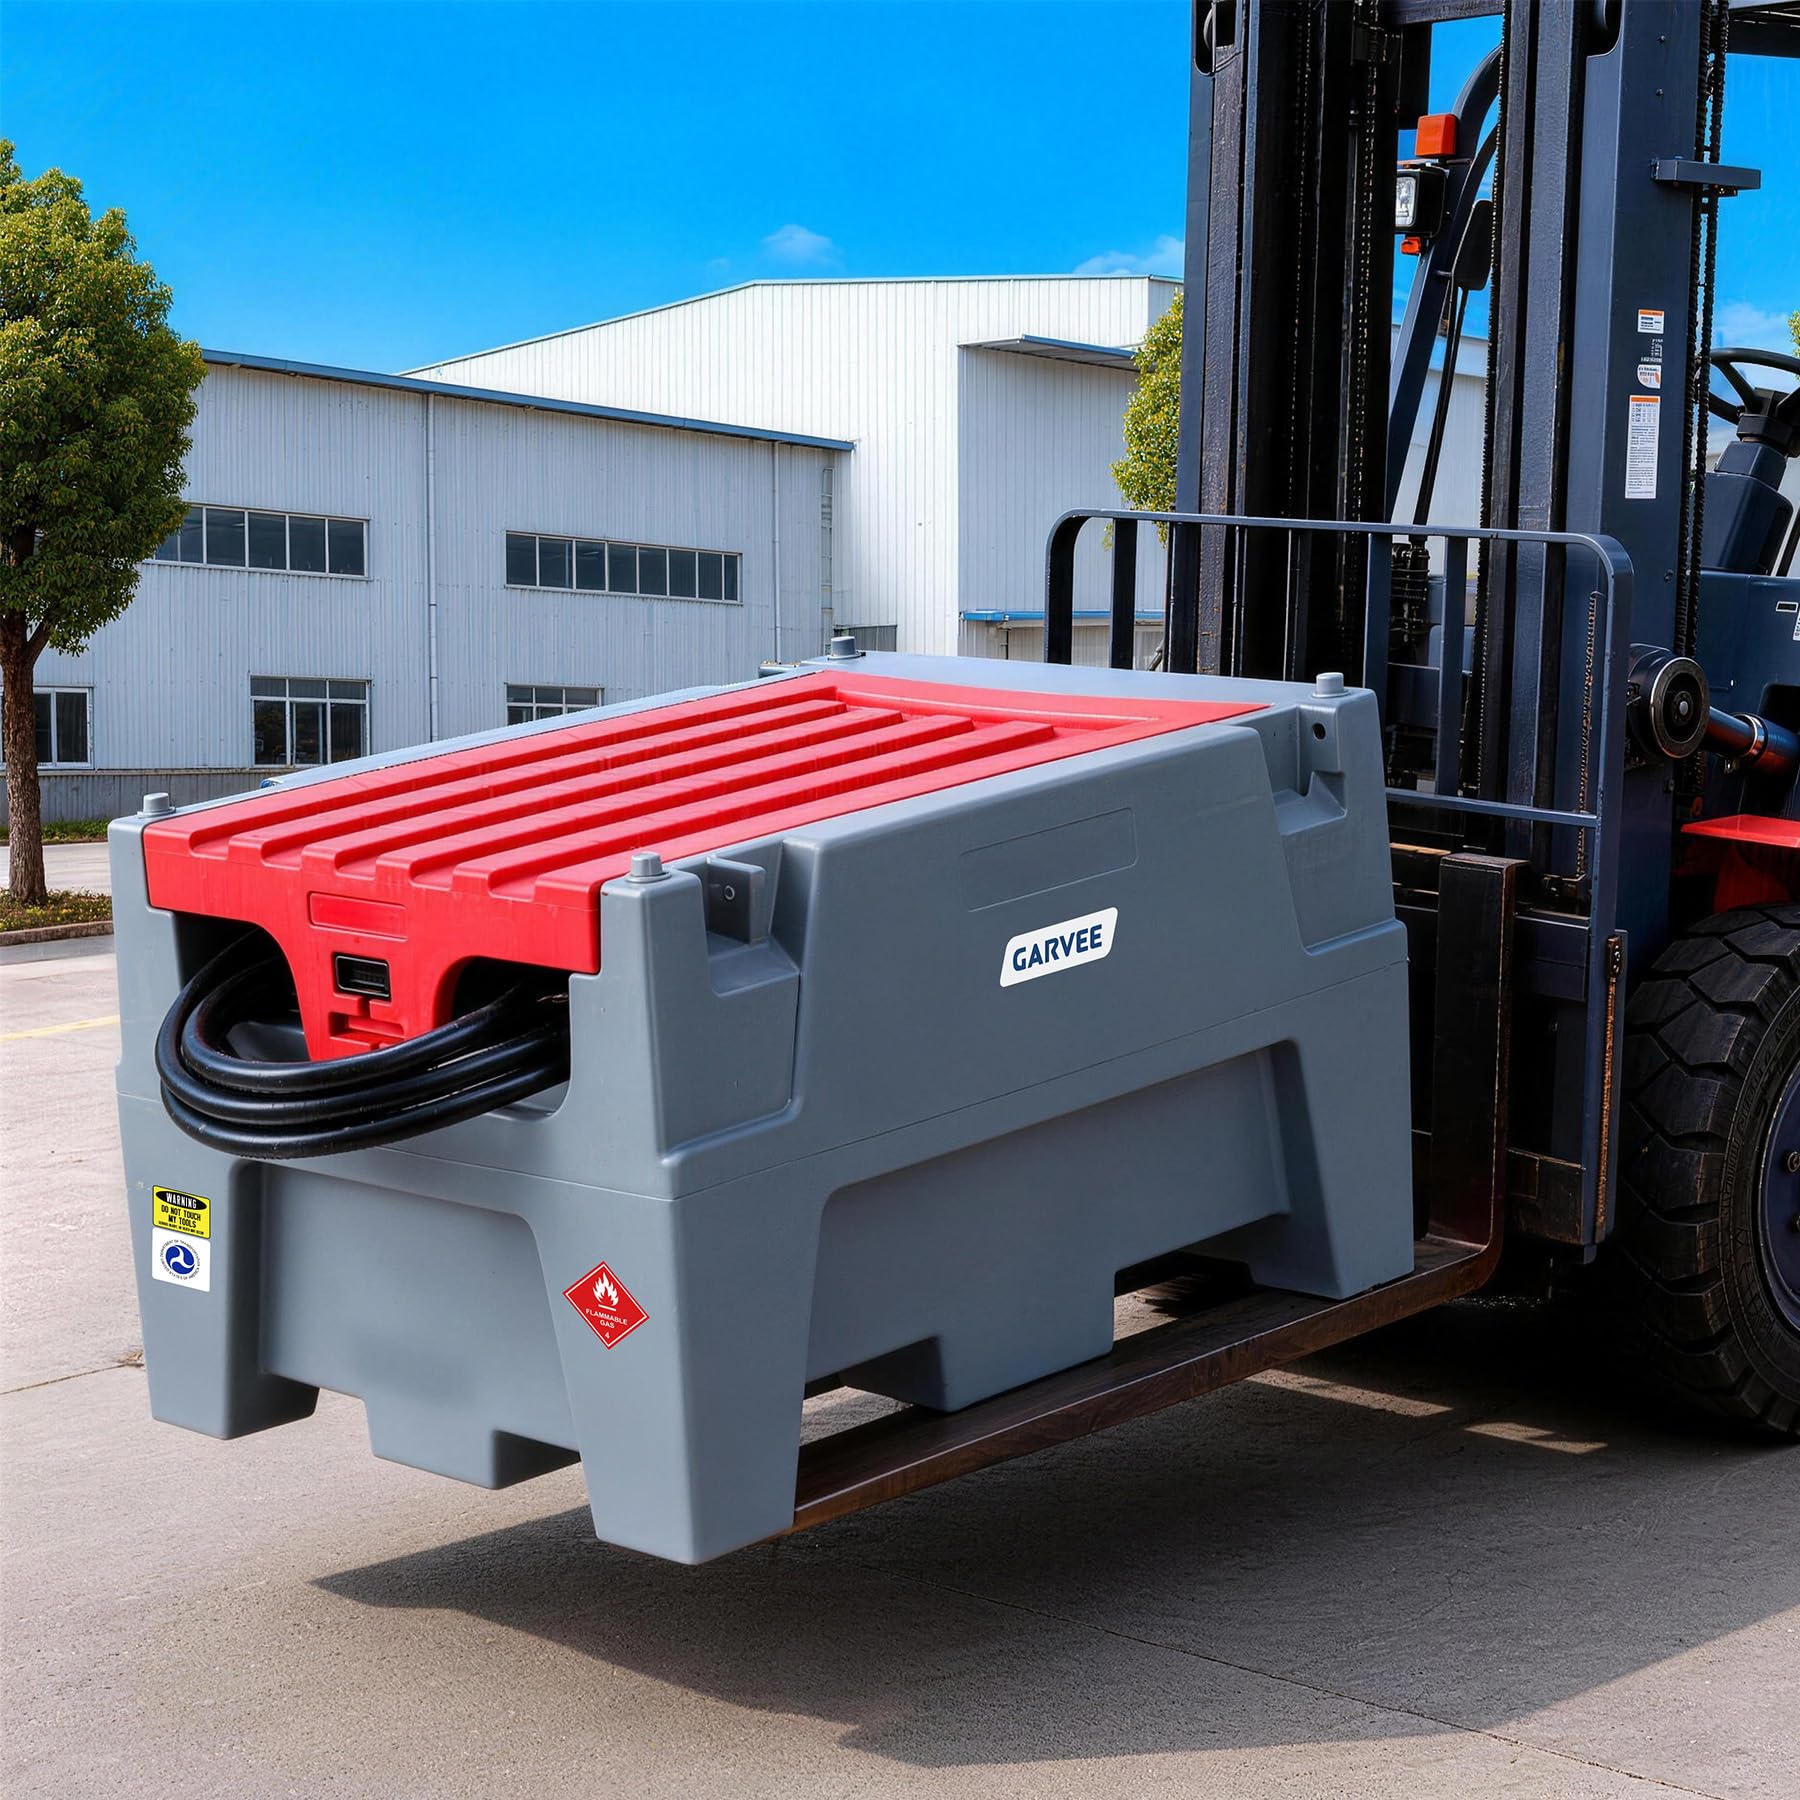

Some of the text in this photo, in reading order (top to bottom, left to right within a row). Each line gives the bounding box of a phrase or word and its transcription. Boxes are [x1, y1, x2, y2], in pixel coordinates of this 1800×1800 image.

[1012, 923, 1103, 972] GARVEE
[165, 1192, 197, 1209] WARNING
[161, 1204, 201, 1222] DO NOT TOUCH
[168, 1214, 176, 1224] MY
[179, 1216, 197, 1229] TOOLS
[585, 1308, 629, 1326] FLAMMABLE
[599, 1319, 615, 1329] GAS
